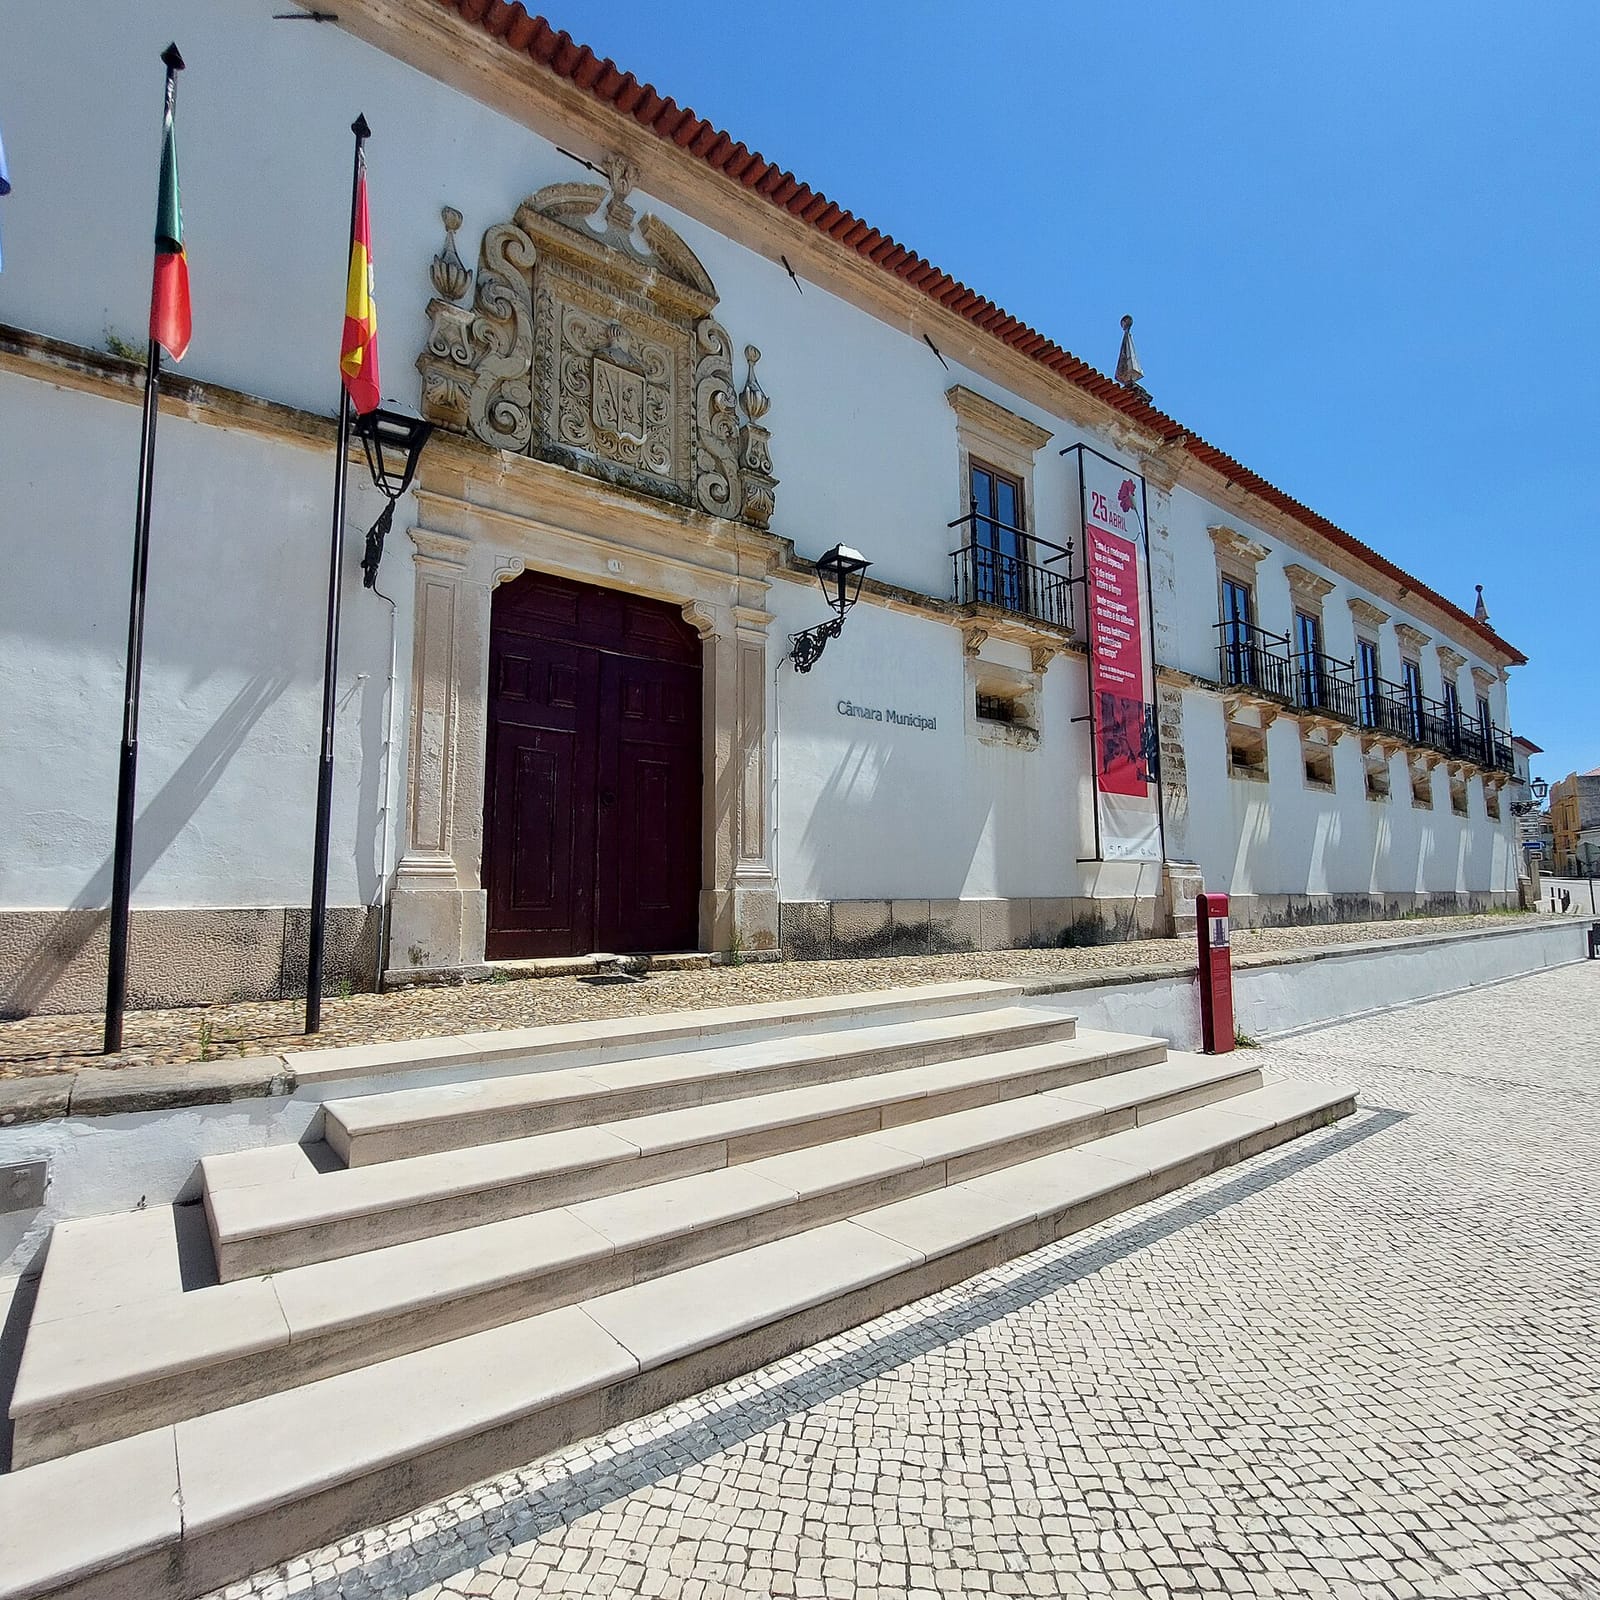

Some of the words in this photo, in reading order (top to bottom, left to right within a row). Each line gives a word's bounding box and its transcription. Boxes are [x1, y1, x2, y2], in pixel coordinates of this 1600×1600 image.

[1092, 491, 1107, 522] 25
[1109, 511, 1128, 532] ABRIL
[837, 699, 883, 722] Câmara
[886, 709, 937, 731] Municipal
